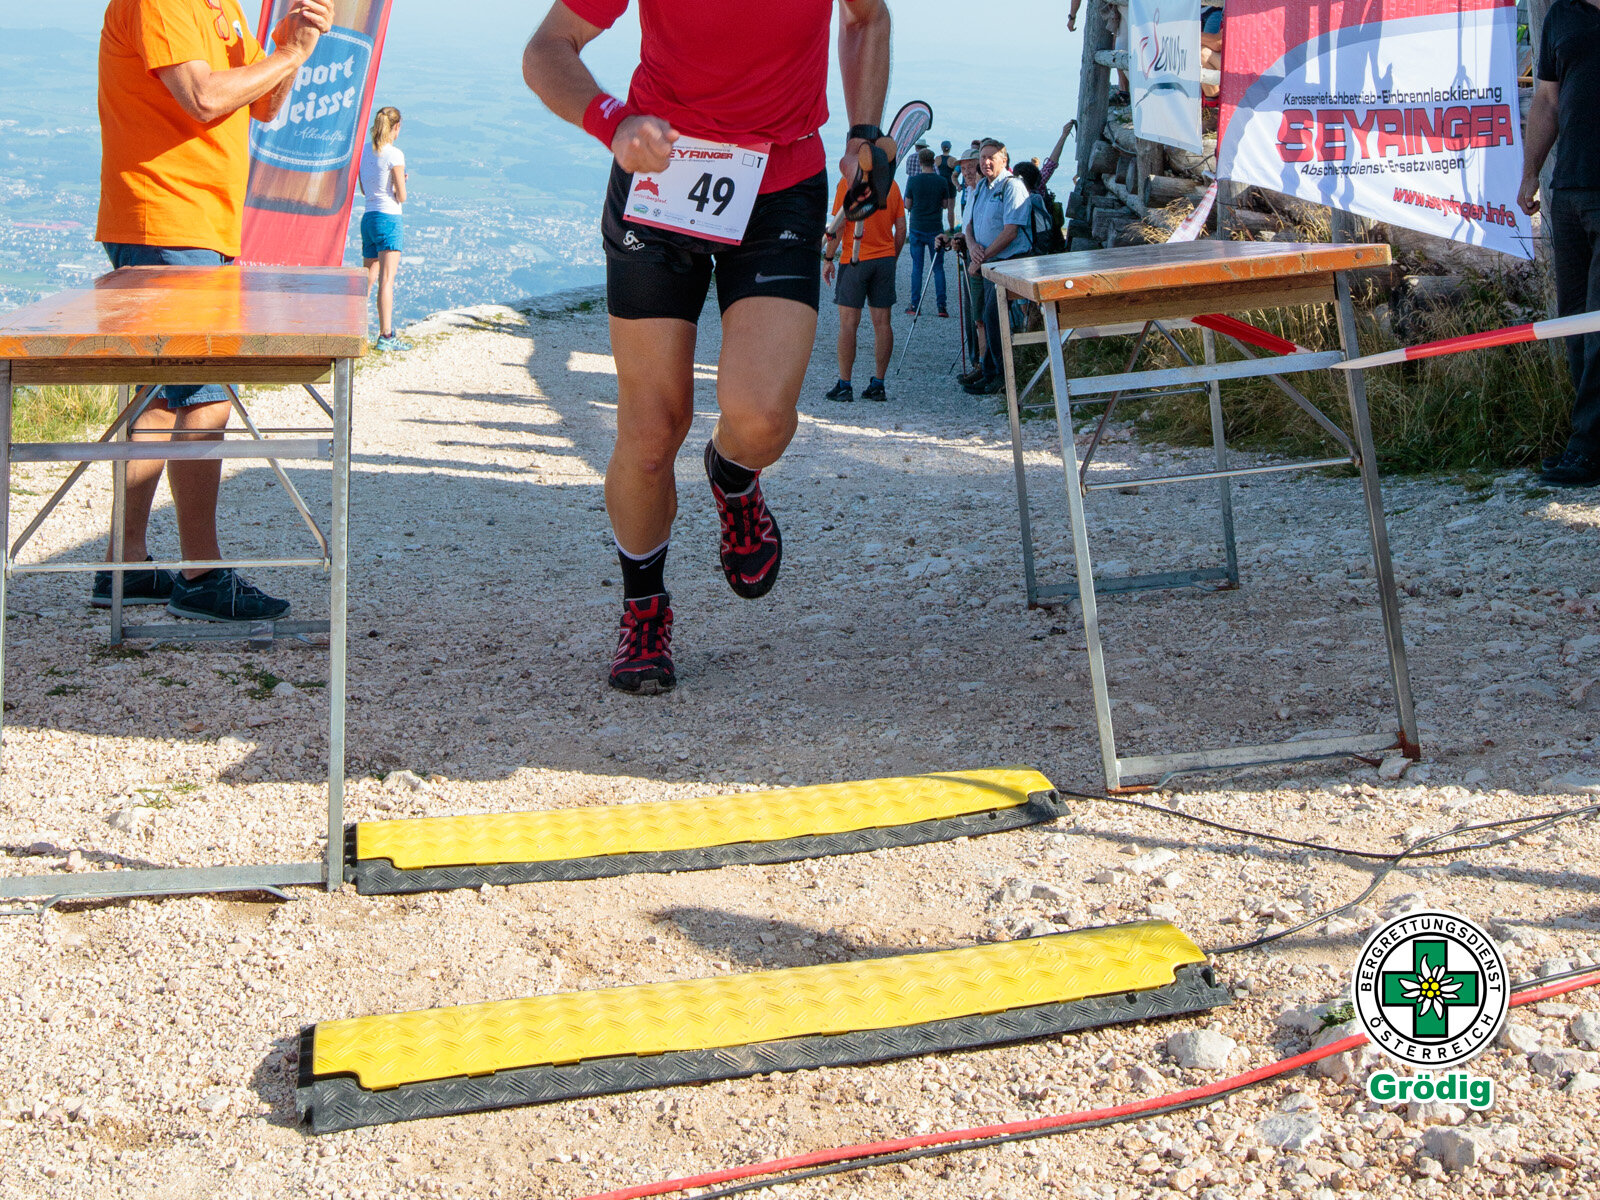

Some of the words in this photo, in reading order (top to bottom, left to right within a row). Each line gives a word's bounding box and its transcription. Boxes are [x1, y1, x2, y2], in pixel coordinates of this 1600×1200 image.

[294, 54, 355, 92] port
[1275, 104, 1514, 163] SEYRINGER
[669, 147, 733, 160] EYRINGER
[756, 156, 764, 169] T
[687, 172, 735, 216] 49
